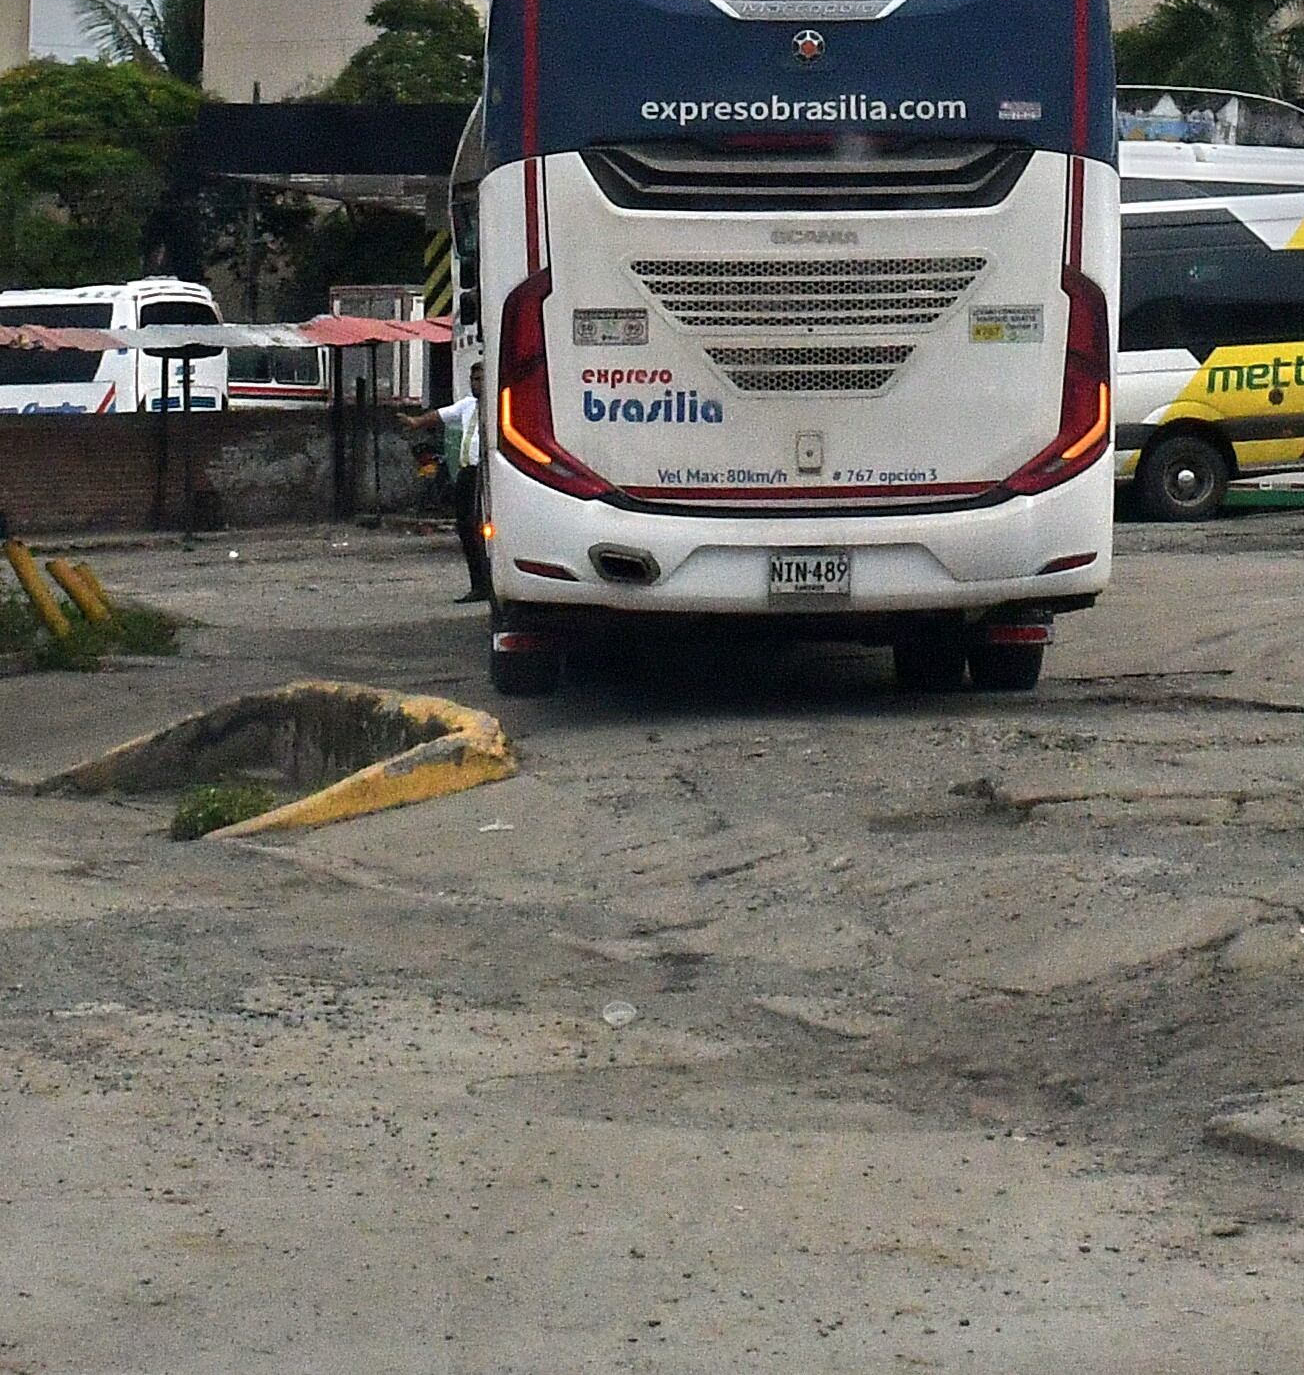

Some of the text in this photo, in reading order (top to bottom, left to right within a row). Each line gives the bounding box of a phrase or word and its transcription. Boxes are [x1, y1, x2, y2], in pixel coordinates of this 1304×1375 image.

[640, 95, 967, 126] expresobrasilia.com
[581, 368, 673, 389] expreso
[583, 390, 723, 423] brasilia
[658, 469, 684, 484] Vel
[847, 470, 874, 482] 767
[879, 469, 926, 485] opción
[929, 469, 938, 482] 3
